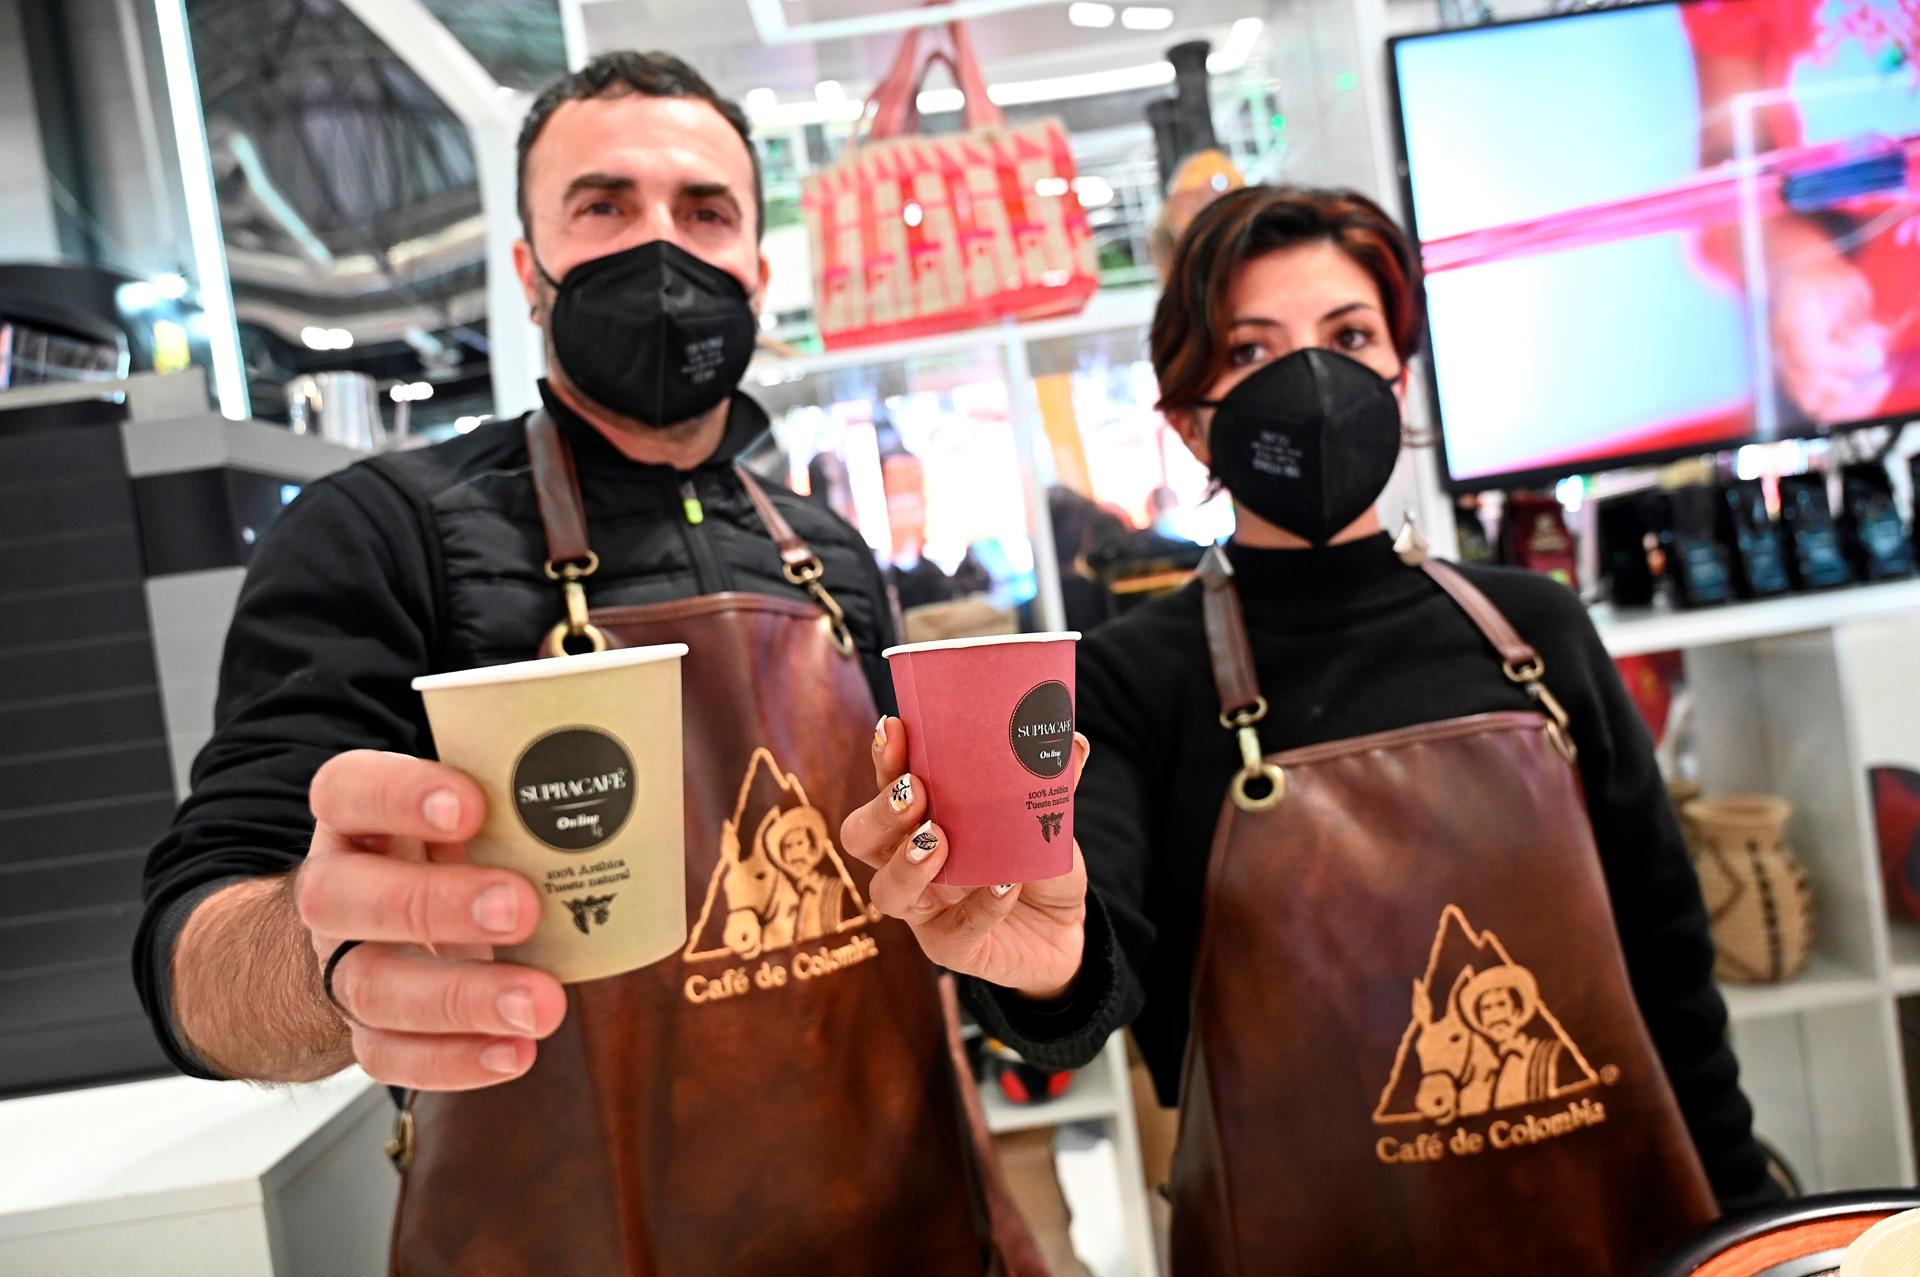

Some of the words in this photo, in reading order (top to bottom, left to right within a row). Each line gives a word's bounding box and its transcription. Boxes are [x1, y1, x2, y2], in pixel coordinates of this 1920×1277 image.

[1028, 789, 1047, 800] 100%
[1025, 800, 1051, 810] Tueste
[588, 867, 631, 887] natural
[684, 967, 750, 1003] Café
[755, 961, 788, 989] de
[1376, 1132, 1444, 1164] Café
[1450, 1127, 1484, 1156] de
[1489, 1097, 1606, 1148] Colombia
